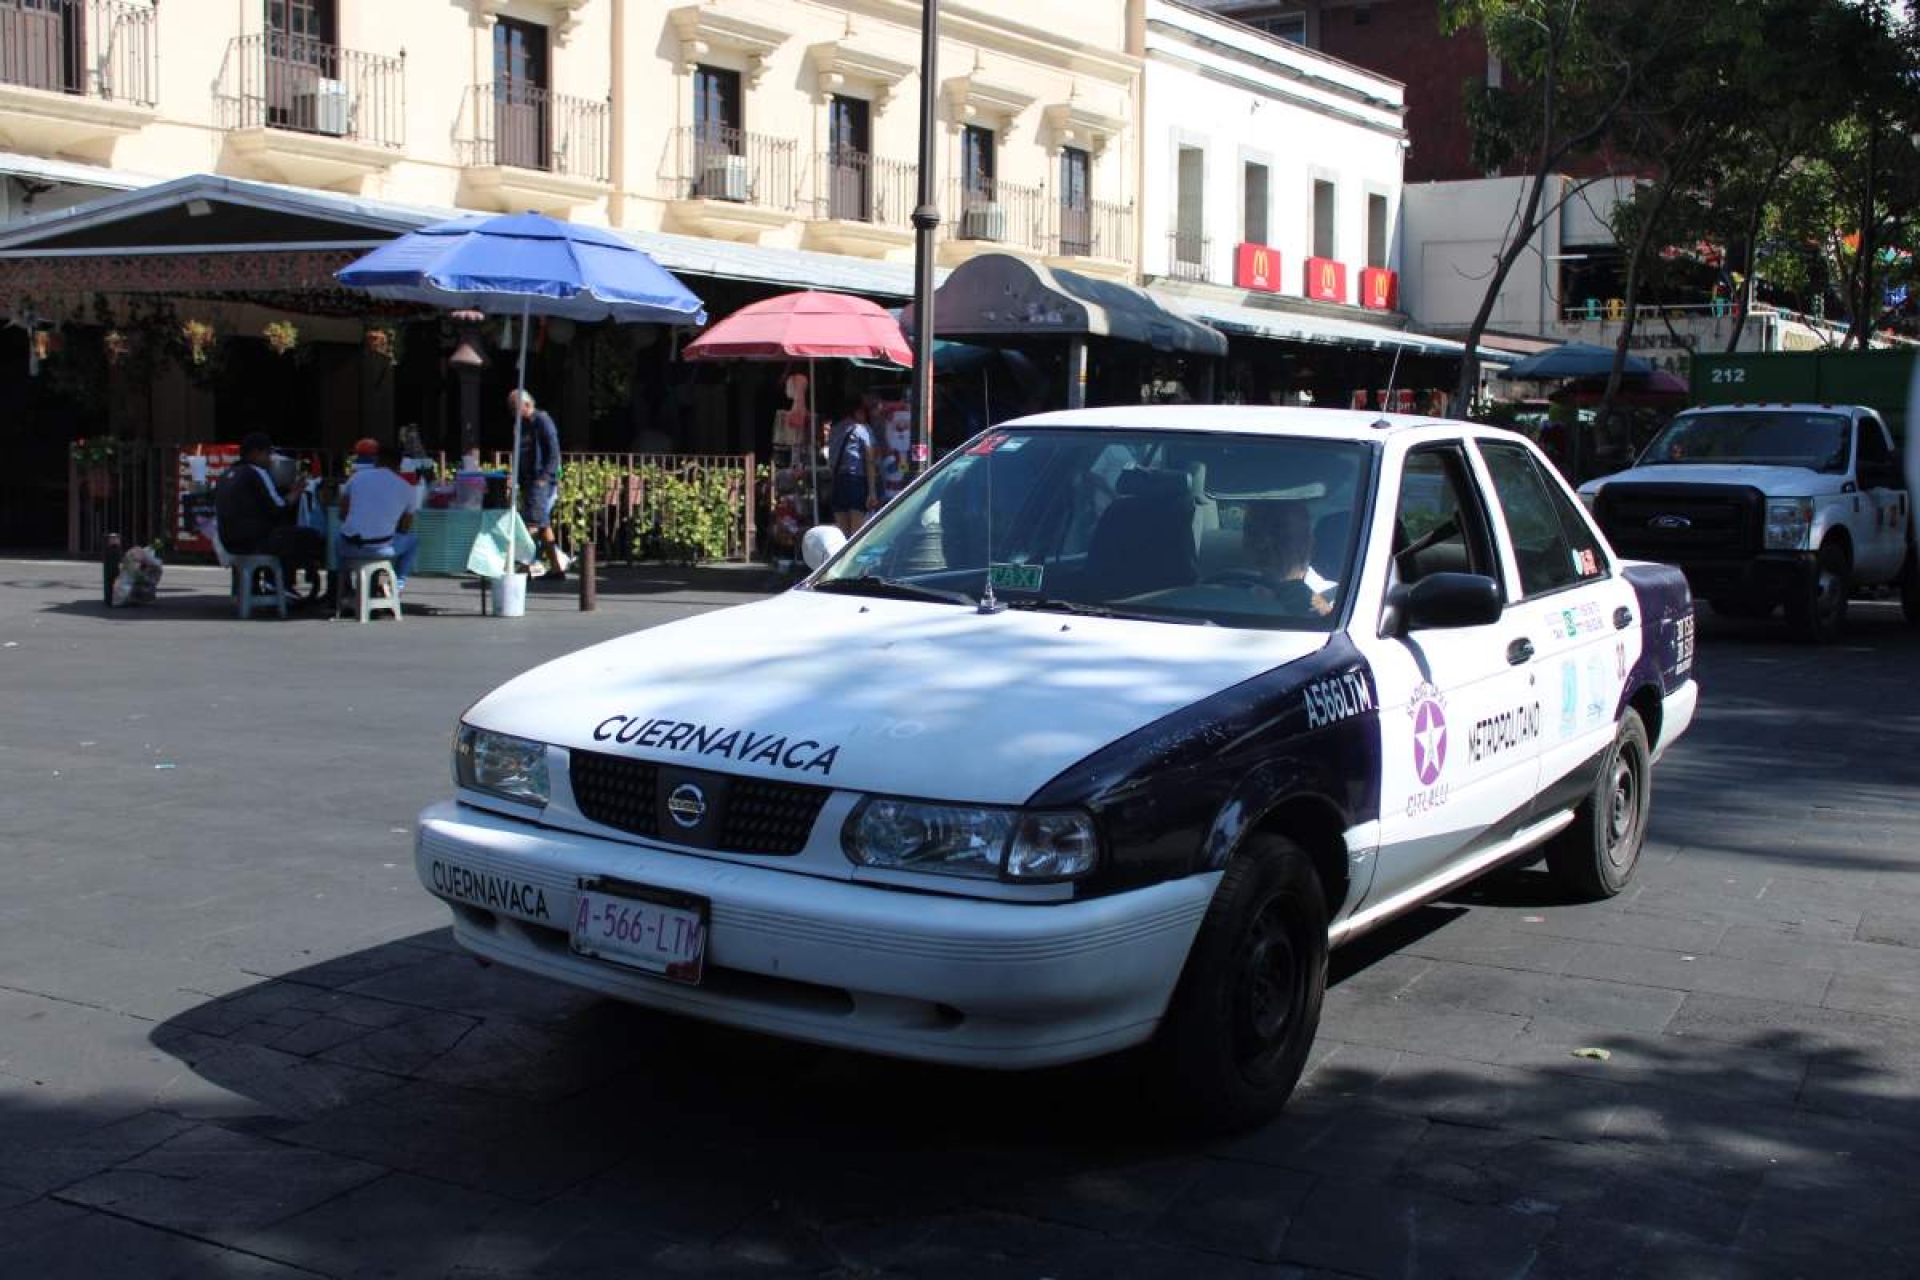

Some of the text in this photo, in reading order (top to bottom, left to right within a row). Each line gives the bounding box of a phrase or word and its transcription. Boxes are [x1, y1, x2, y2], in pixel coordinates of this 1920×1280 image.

[1711, 368, 1745, 383] 212
[1303, 670, 1372, 730] A566LTM
[593, 714, 841, 776] CUERNAVACA
[1468, 700, 1540, 767] METROPOLITANO
[431, 859, 551, 920] CUERNAVACA
[575, 895, 701, 960] A-566-LTM
